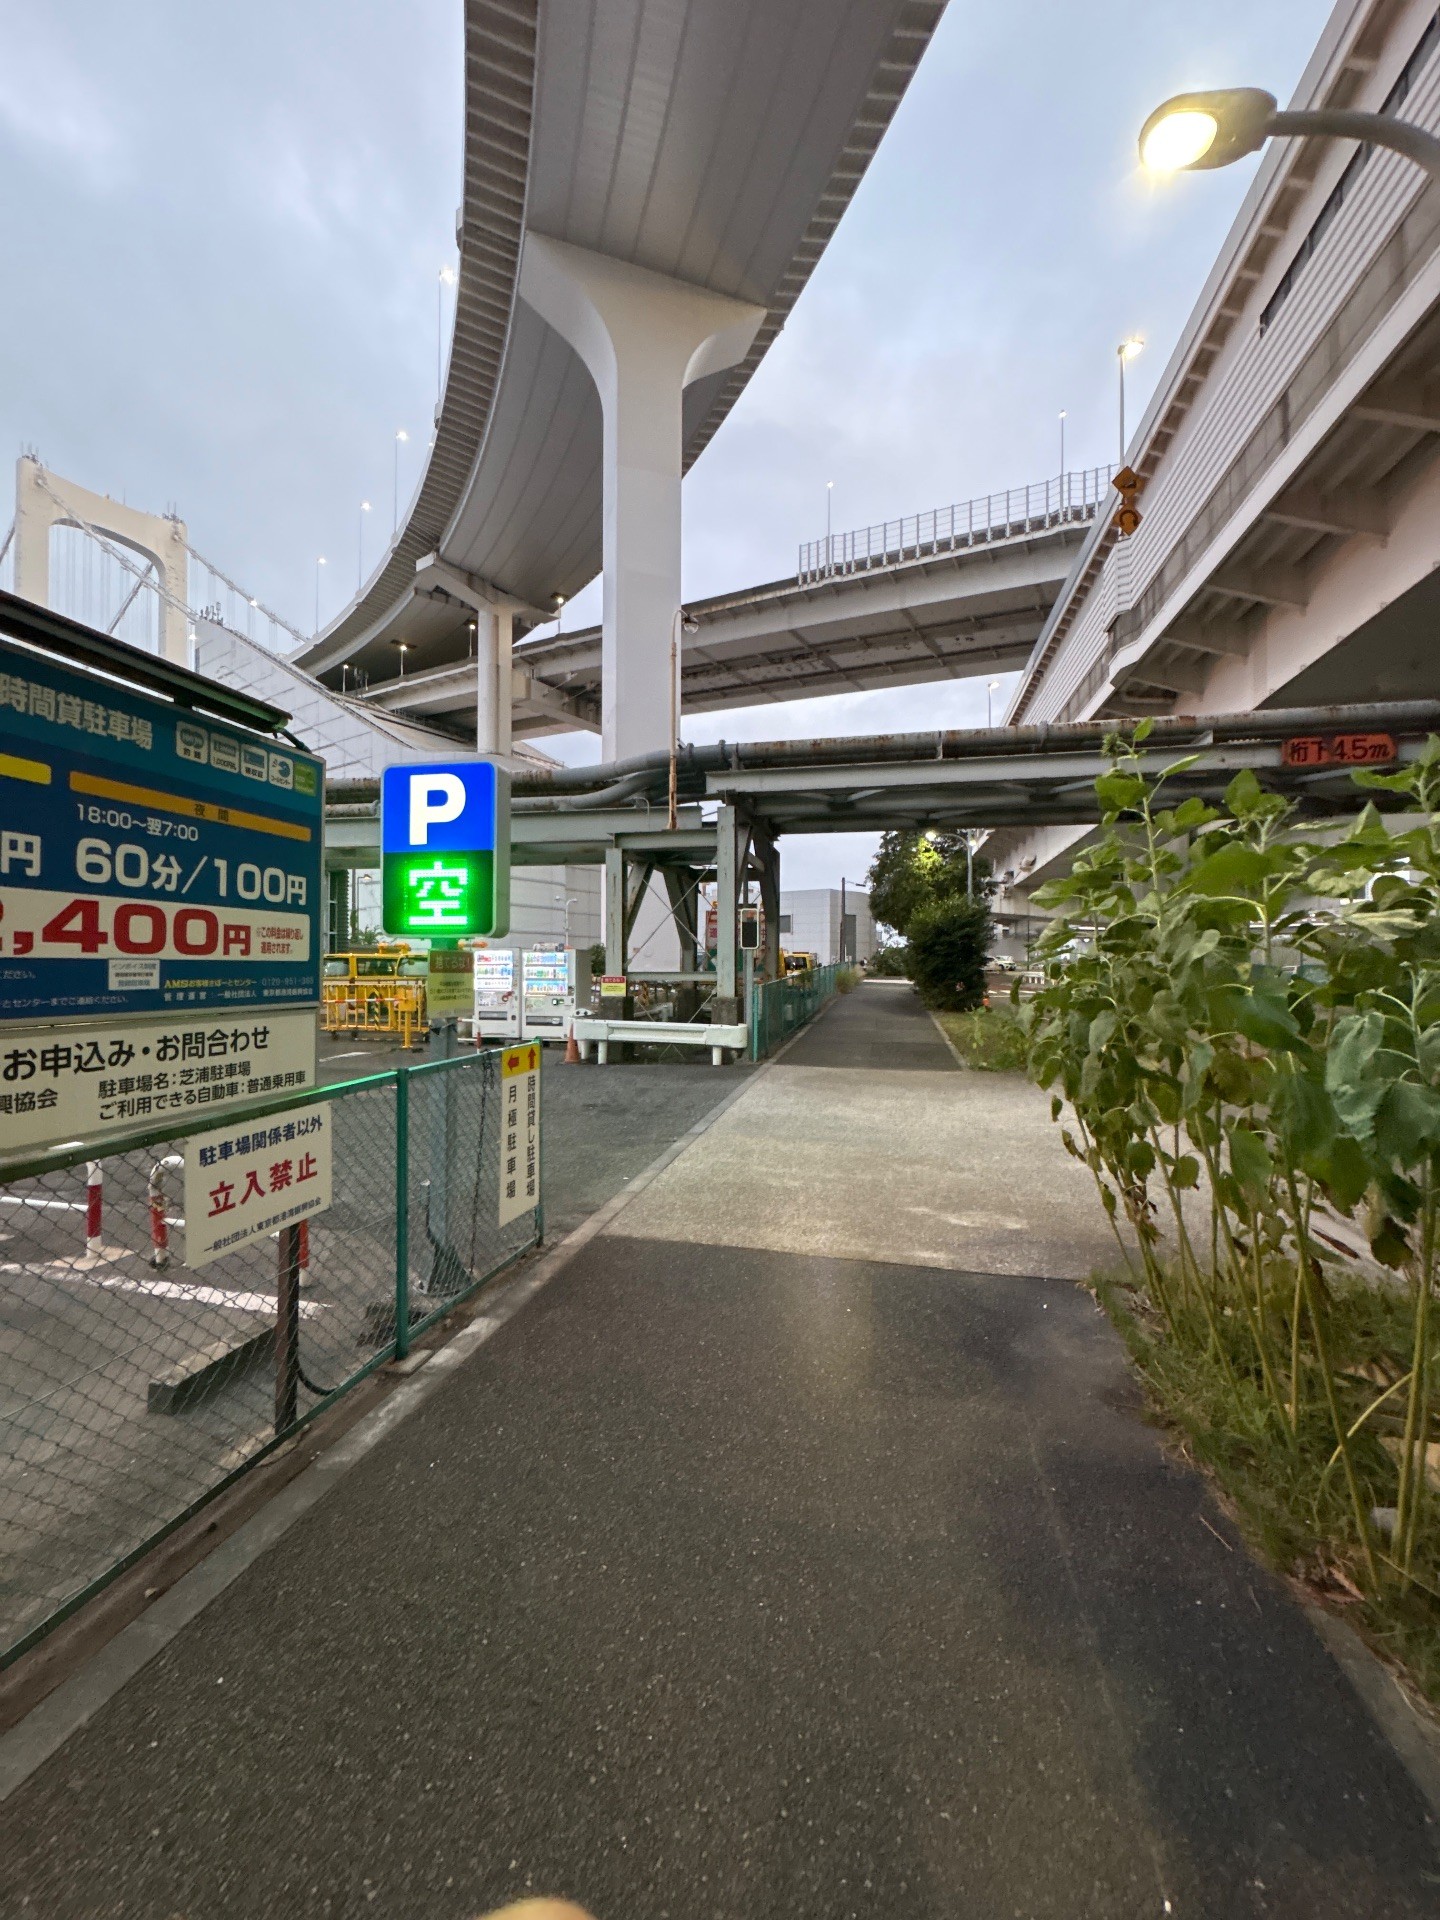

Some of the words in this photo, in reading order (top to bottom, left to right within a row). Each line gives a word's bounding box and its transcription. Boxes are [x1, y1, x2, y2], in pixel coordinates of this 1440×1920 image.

[0, 673, 153, 750] 時間貸駐車場
[409, 772, 466, 845] P
[1, 830, 41, 876] 円
[408, 860, 468, 926] 空
[0, 899, 252, 956] ,400円
[199, 1114, 323, 1168] 駐車場関係者以外
[208, 1152, 318, 1218] 立入禁止
